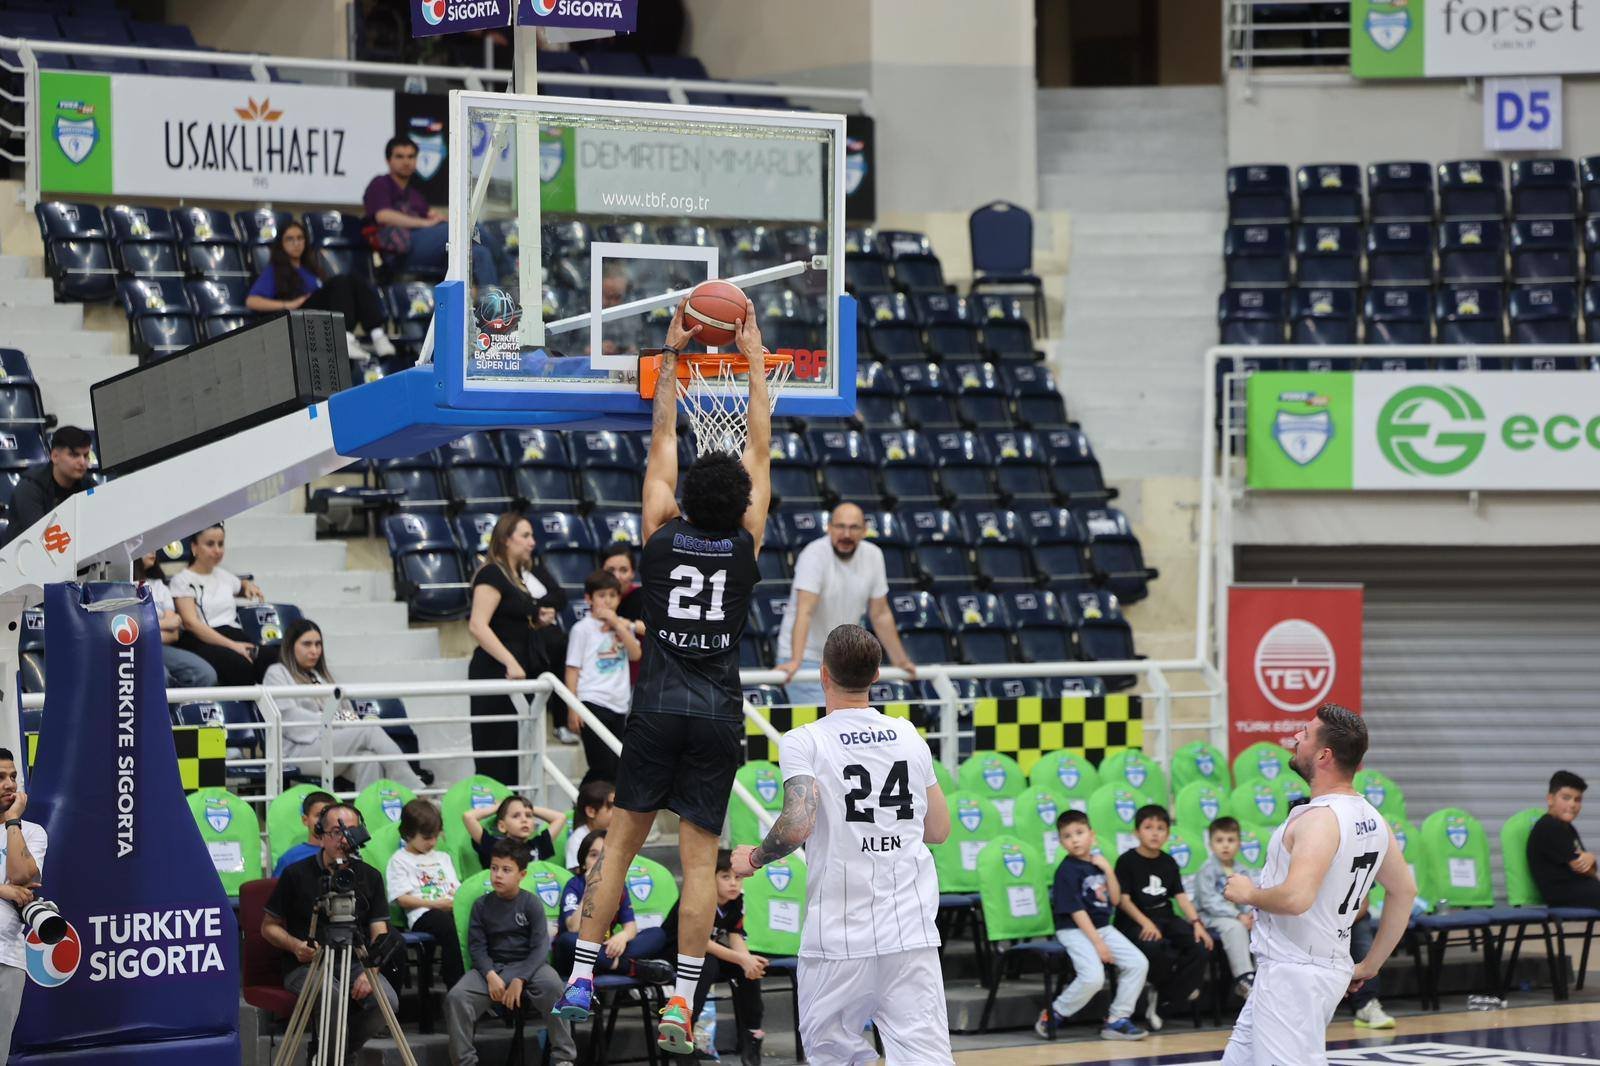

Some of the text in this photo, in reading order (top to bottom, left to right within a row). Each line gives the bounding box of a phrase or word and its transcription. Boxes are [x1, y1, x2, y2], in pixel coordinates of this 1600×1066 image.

[1443, 0, 1584, 35] forset
[1496, 91, 1551, 131] D5
[601, 192, 710, 213] www.tbf.org.tr
[474, 351, 522, 361] BASKETBOL
[476, 359, 520, 370] SÜPER LİGİ
[667, 564, 727, 621] 21
[659, 629, 731, 650] SAZALON
[1264, 668, 1327, 690] TEV
[843, 760, 914, 824] 24
[861, 835, 902, 852] ALEN
